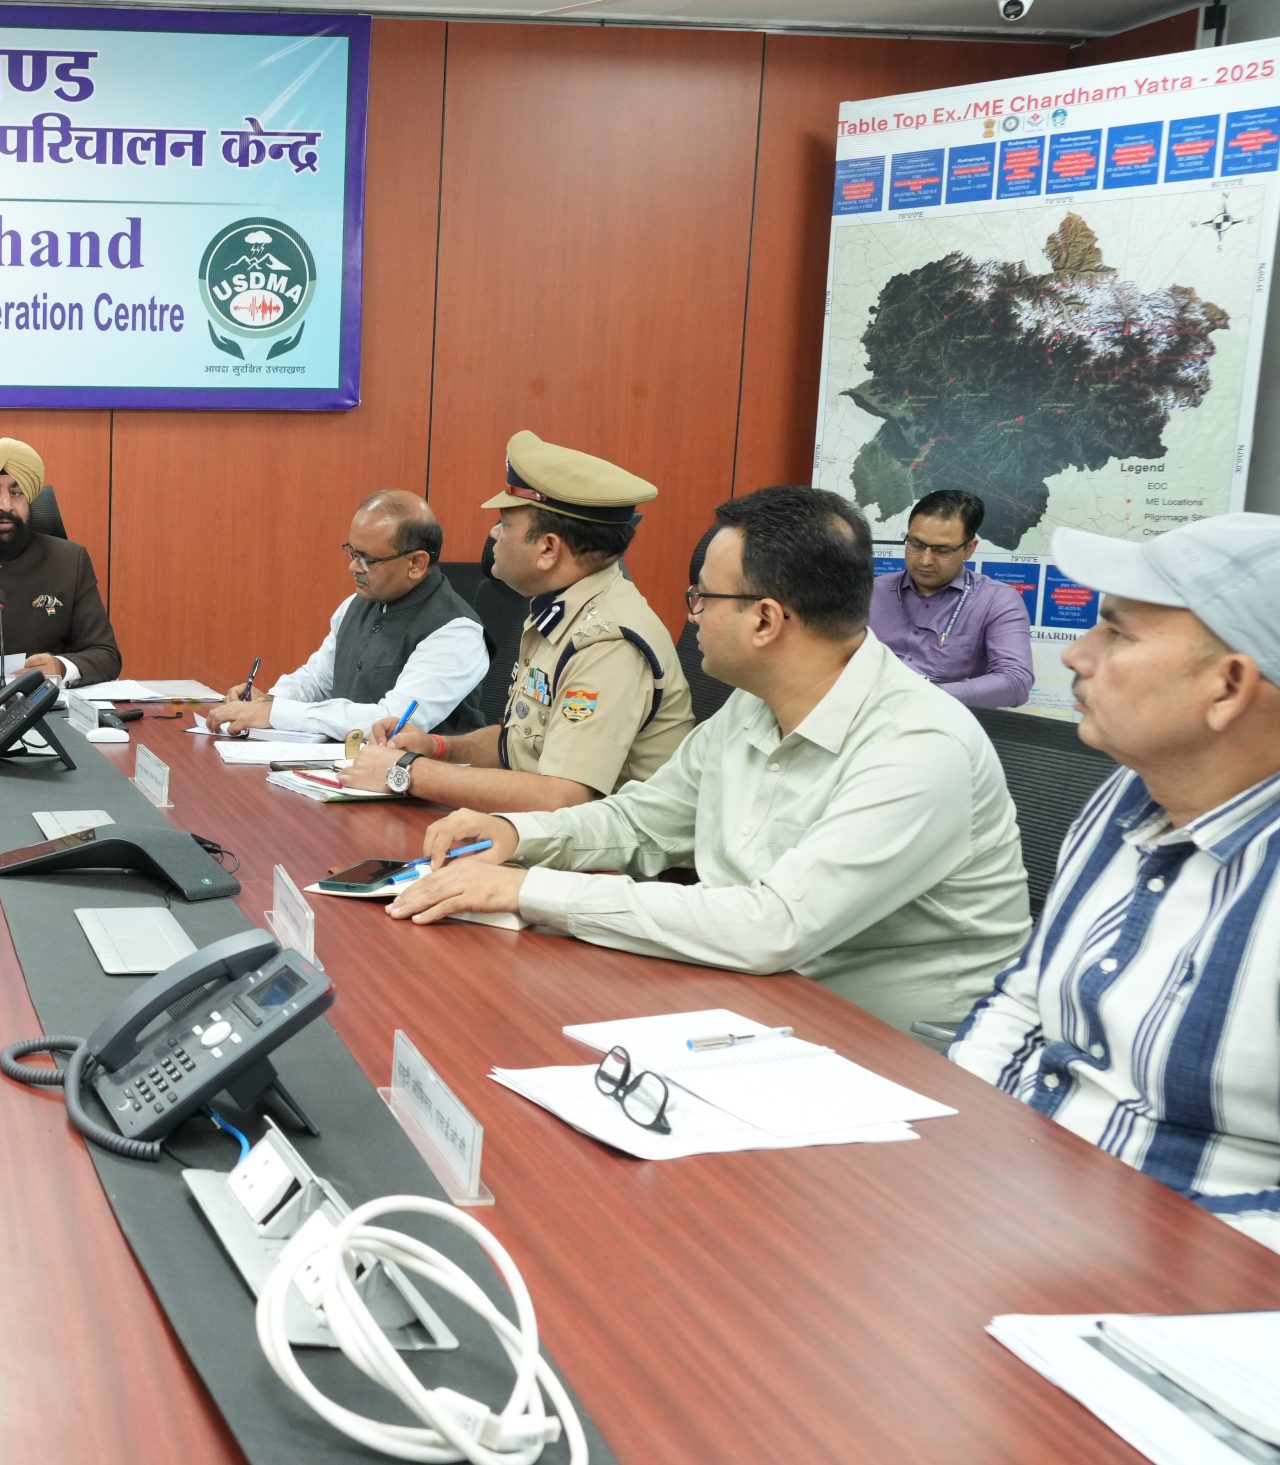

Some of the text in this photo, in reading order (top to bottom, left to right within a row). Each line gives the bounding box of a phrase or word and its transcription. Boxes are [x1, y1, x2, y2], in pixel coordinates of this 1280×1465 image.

[837, 118, 888, 136] Table
[893, 112, 927, 129] Top
[933, 99, 1004, 123] Ex./ME
[1010, 84, 1126, 111] Chardham
[1134, 75, 1193, 96] Yatra
[1215, 60, 1275, 84] 2025
[220, 117, 322, 175] केन्द्र
[212, 271, 303, 305] USDMA
[93, 292, 185, 334] Centre
[204, 363, 306, 376] आपदा सुरक्षित उत्तराखण्ड
[1120, 463, 1166, 474] Legend
[1147, 482, 1169, 490] EOC
[1145, 498, 1204, 506] ME Locations
[1144, 513, 1189, 523] Pilgrimage
[1029, 630, 1080, 641] CHARDH
